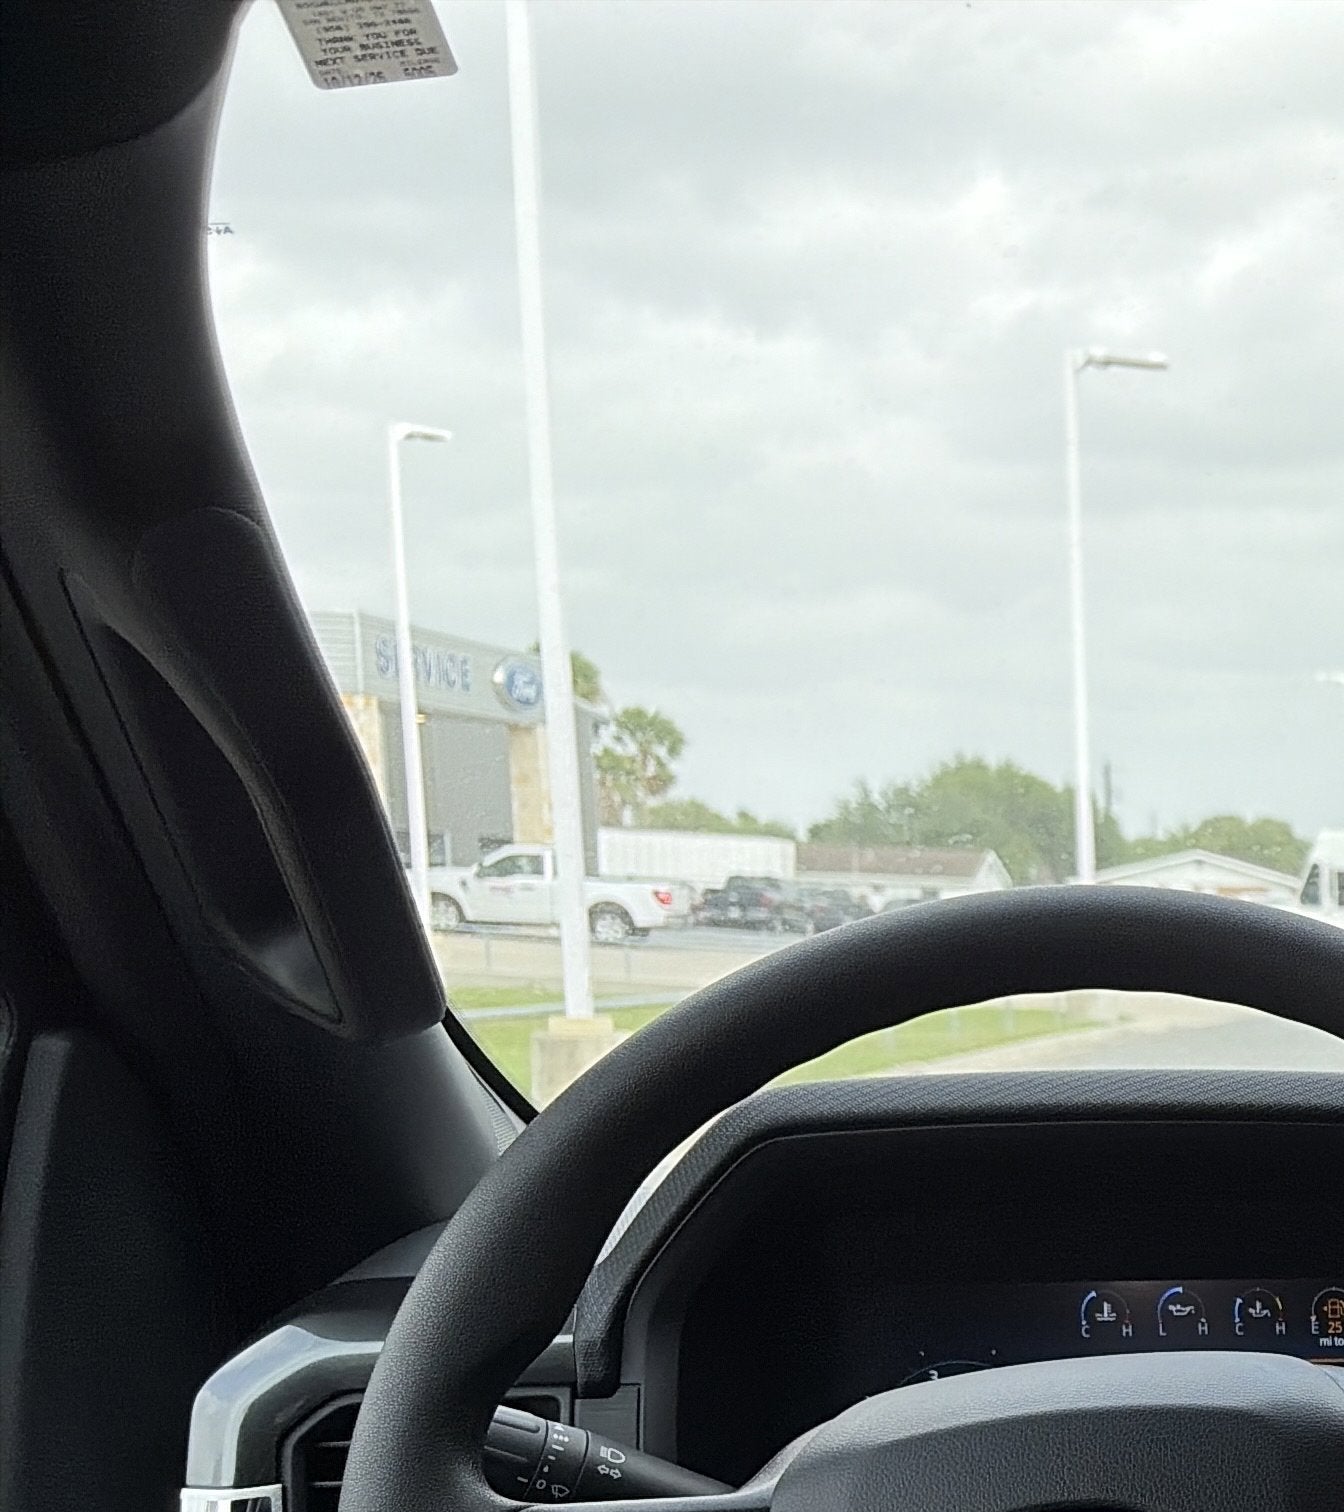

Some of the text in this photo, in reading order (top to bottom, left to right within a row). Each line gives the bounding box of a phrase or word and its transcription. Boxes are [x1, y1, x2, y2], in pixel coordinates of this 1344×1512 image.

[353, 49, 409, 62] SERVICE
[376, 633, 472, 692] SVICE
[1081, 1325, 1091, 1338] C
[1122, 1325, 1133, 1338] H
[1159, 1324, 1167, 1337] L
[1198, 1323, 1209, 1336] H
[1235, 1323, 1245, 1336] C
[1275, 1322, 1286, 1335] H
[1327, 1321, 1343, 1334] 25
[1319, 1335, 1333, 1347] mi
[1334, 1336, 1344, 1347] to
